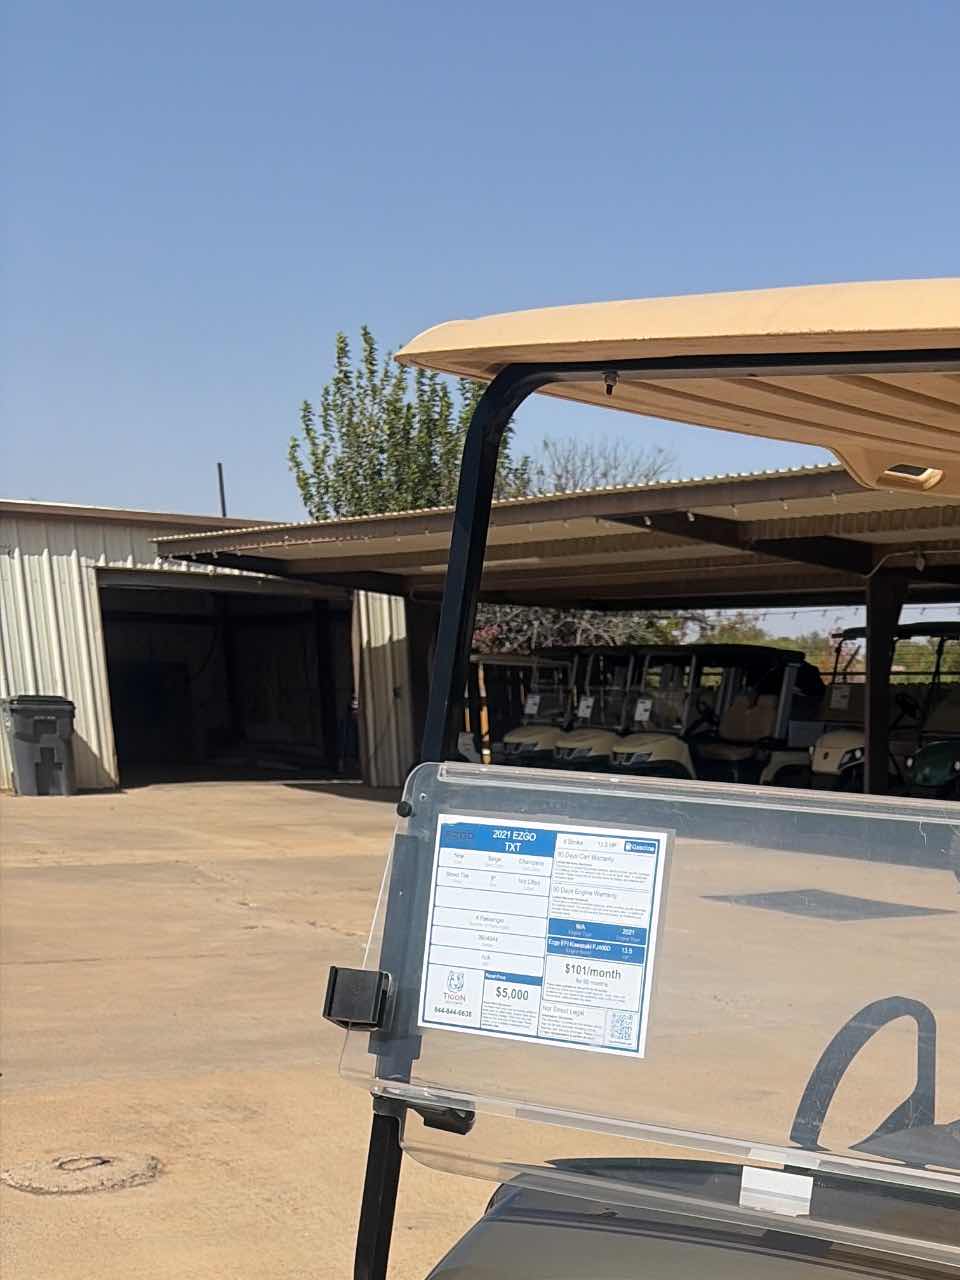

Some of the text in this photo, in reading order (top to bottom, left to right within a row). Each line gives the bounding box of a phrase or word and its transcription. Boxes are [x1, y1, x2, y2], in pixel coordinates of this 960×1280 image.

[493, 829, 537, 841] 2021 EZGO
[505, 841, 522, 852] TXT
[565, 963, 622, 980] $101/month
[495, 986, 529, 1001] $5,000
